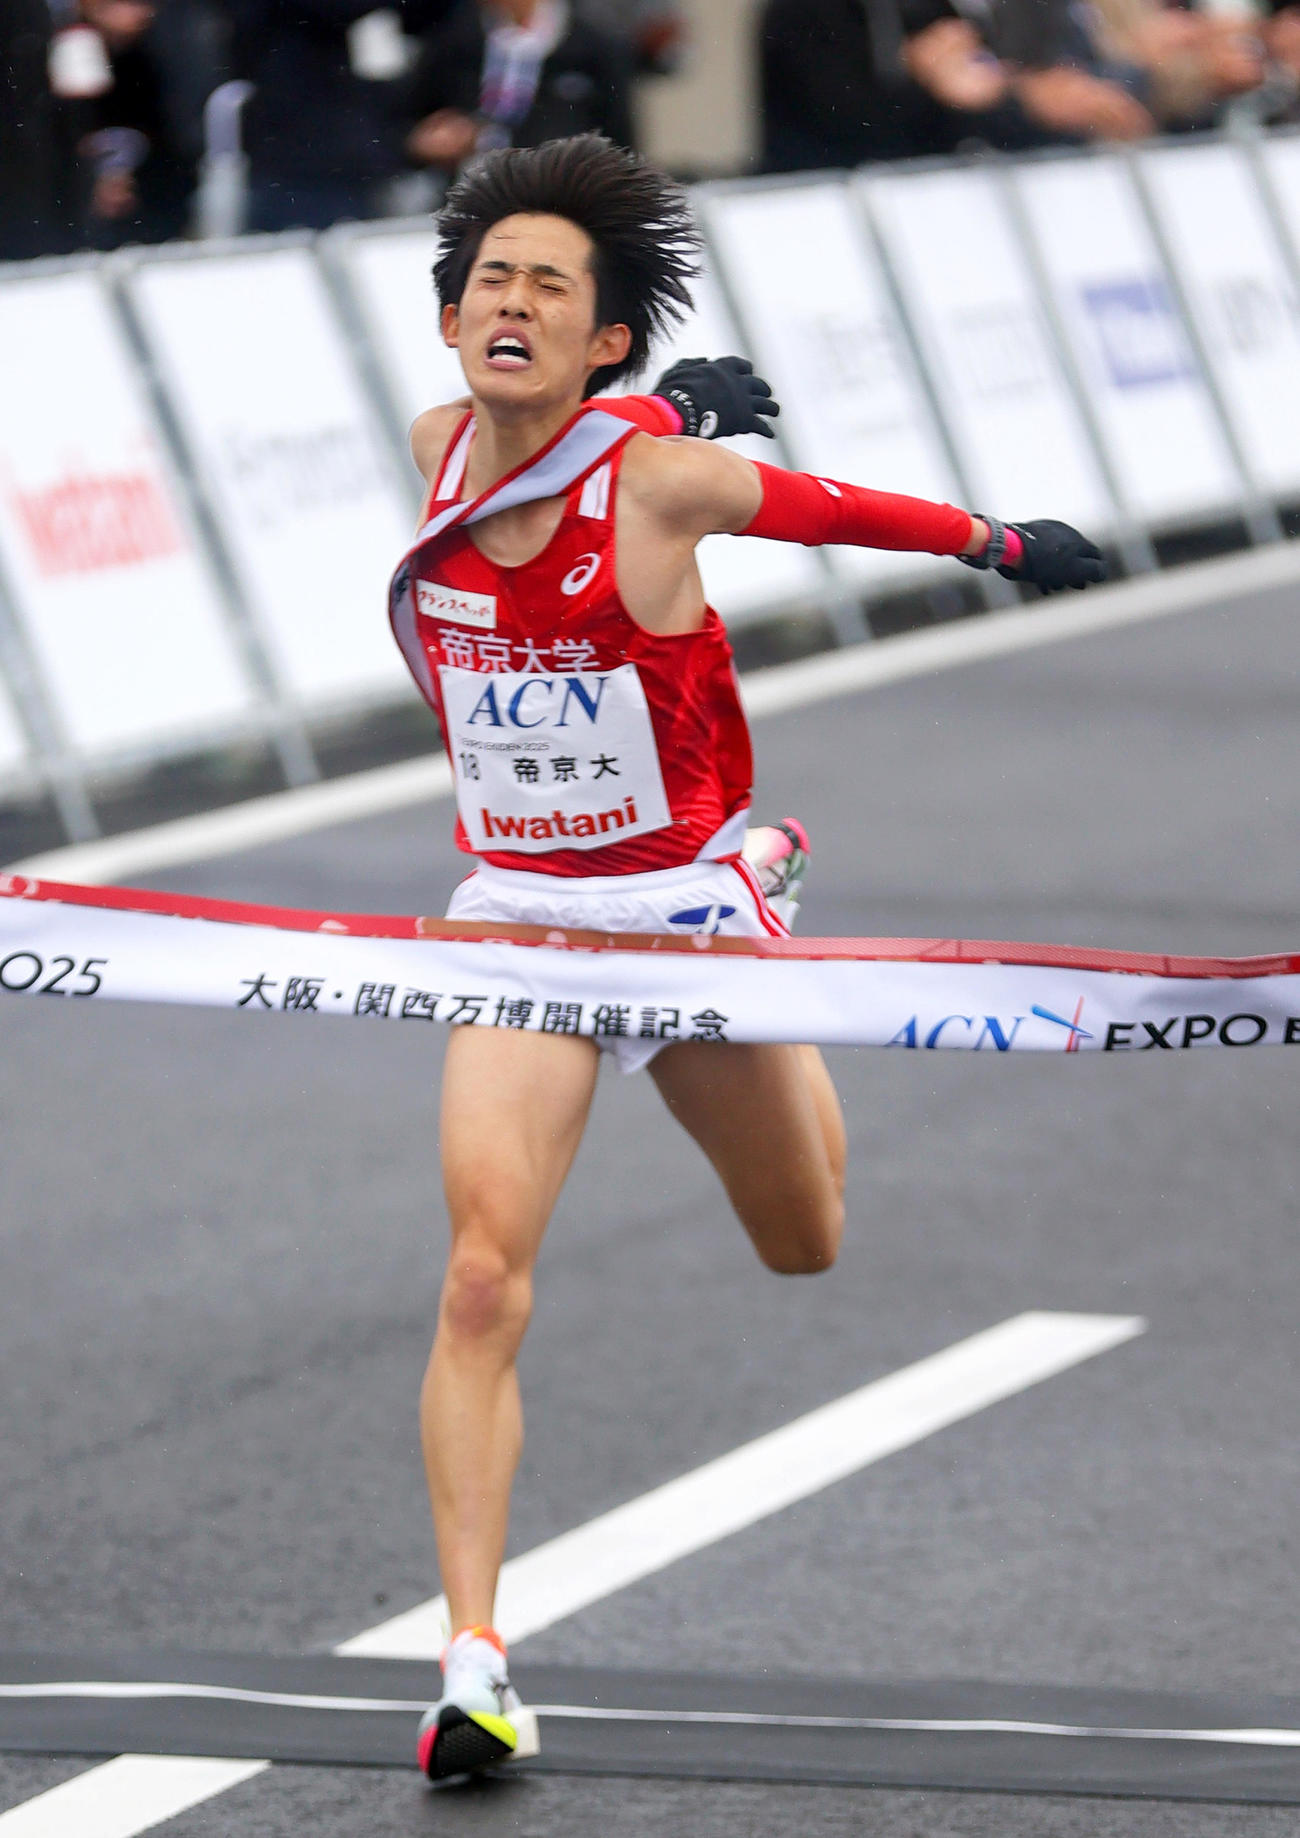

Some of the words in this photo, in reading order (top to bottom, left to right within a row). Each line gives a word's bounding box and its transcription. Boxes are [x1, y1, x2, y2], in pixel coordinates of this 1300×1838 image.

[437, 628, 600, 673] 帝京大学
[466, 676, 608, 728] ACN
[513, 753, 620, 783] 帝京大
[480, 796, 639, 839] Iwatani
[237, 973, 729, 1042] 大阪・関西万博開催記念
[882, 1013, 1027, 1051] ACN
[1102, 1013, 1269, 1052] EXPO
